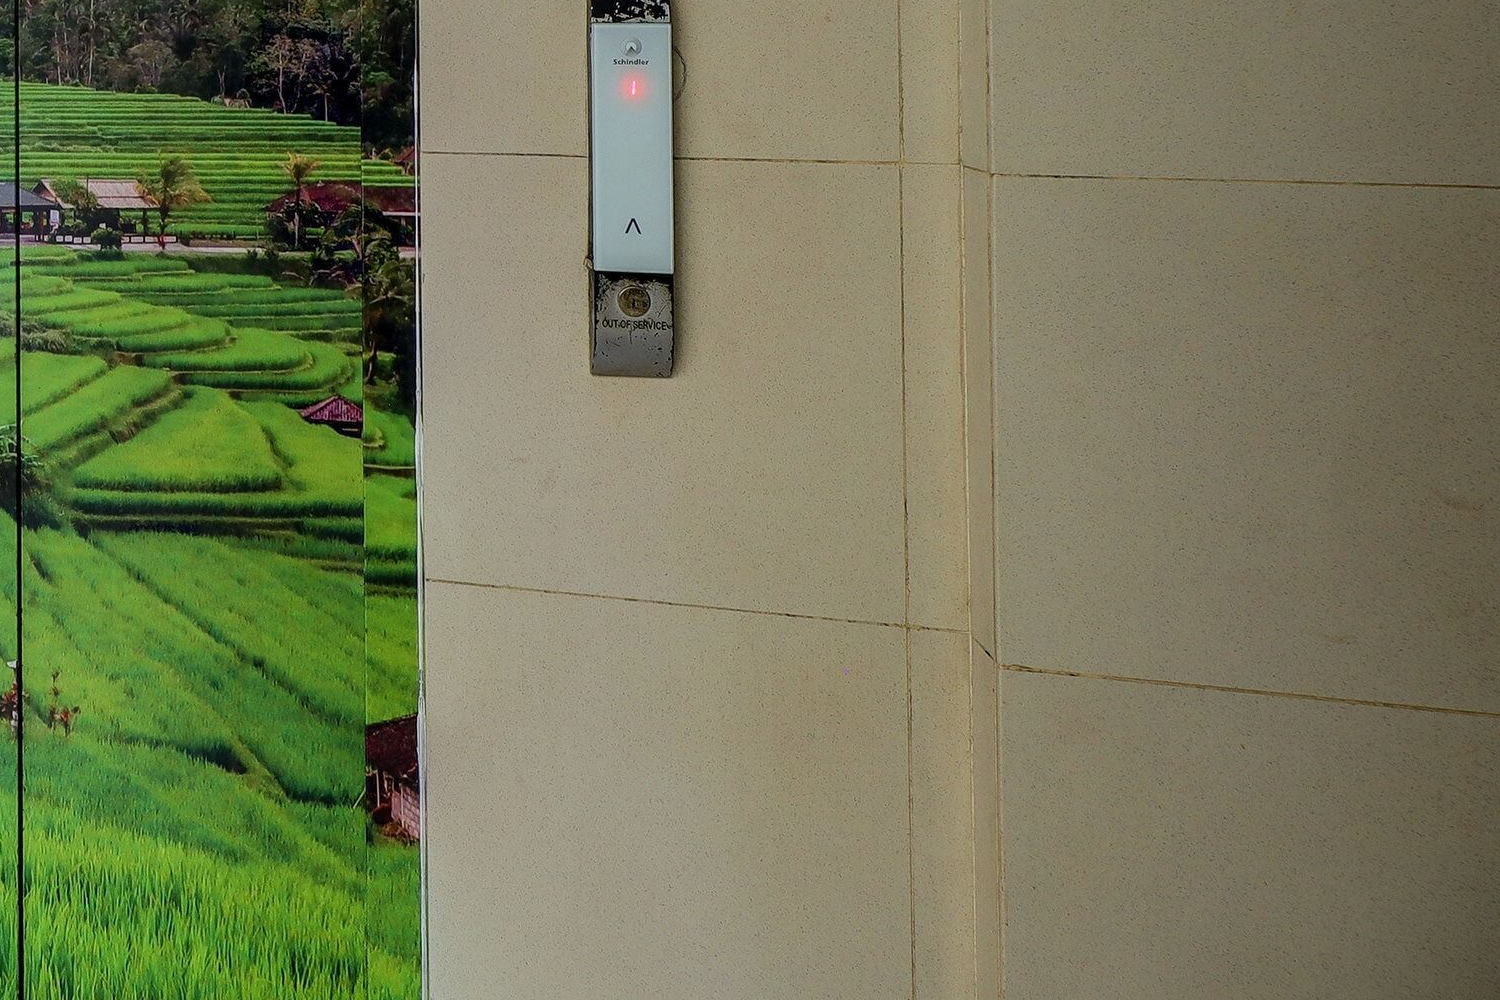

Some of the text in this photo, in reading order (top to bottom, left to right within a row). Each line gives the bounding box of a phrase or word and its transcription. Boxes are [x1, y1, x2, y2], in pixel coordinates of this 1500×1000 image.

[613, 58, 650, 66] Schindler
[602, 320, 667, 331] OUT OF SERVICE
